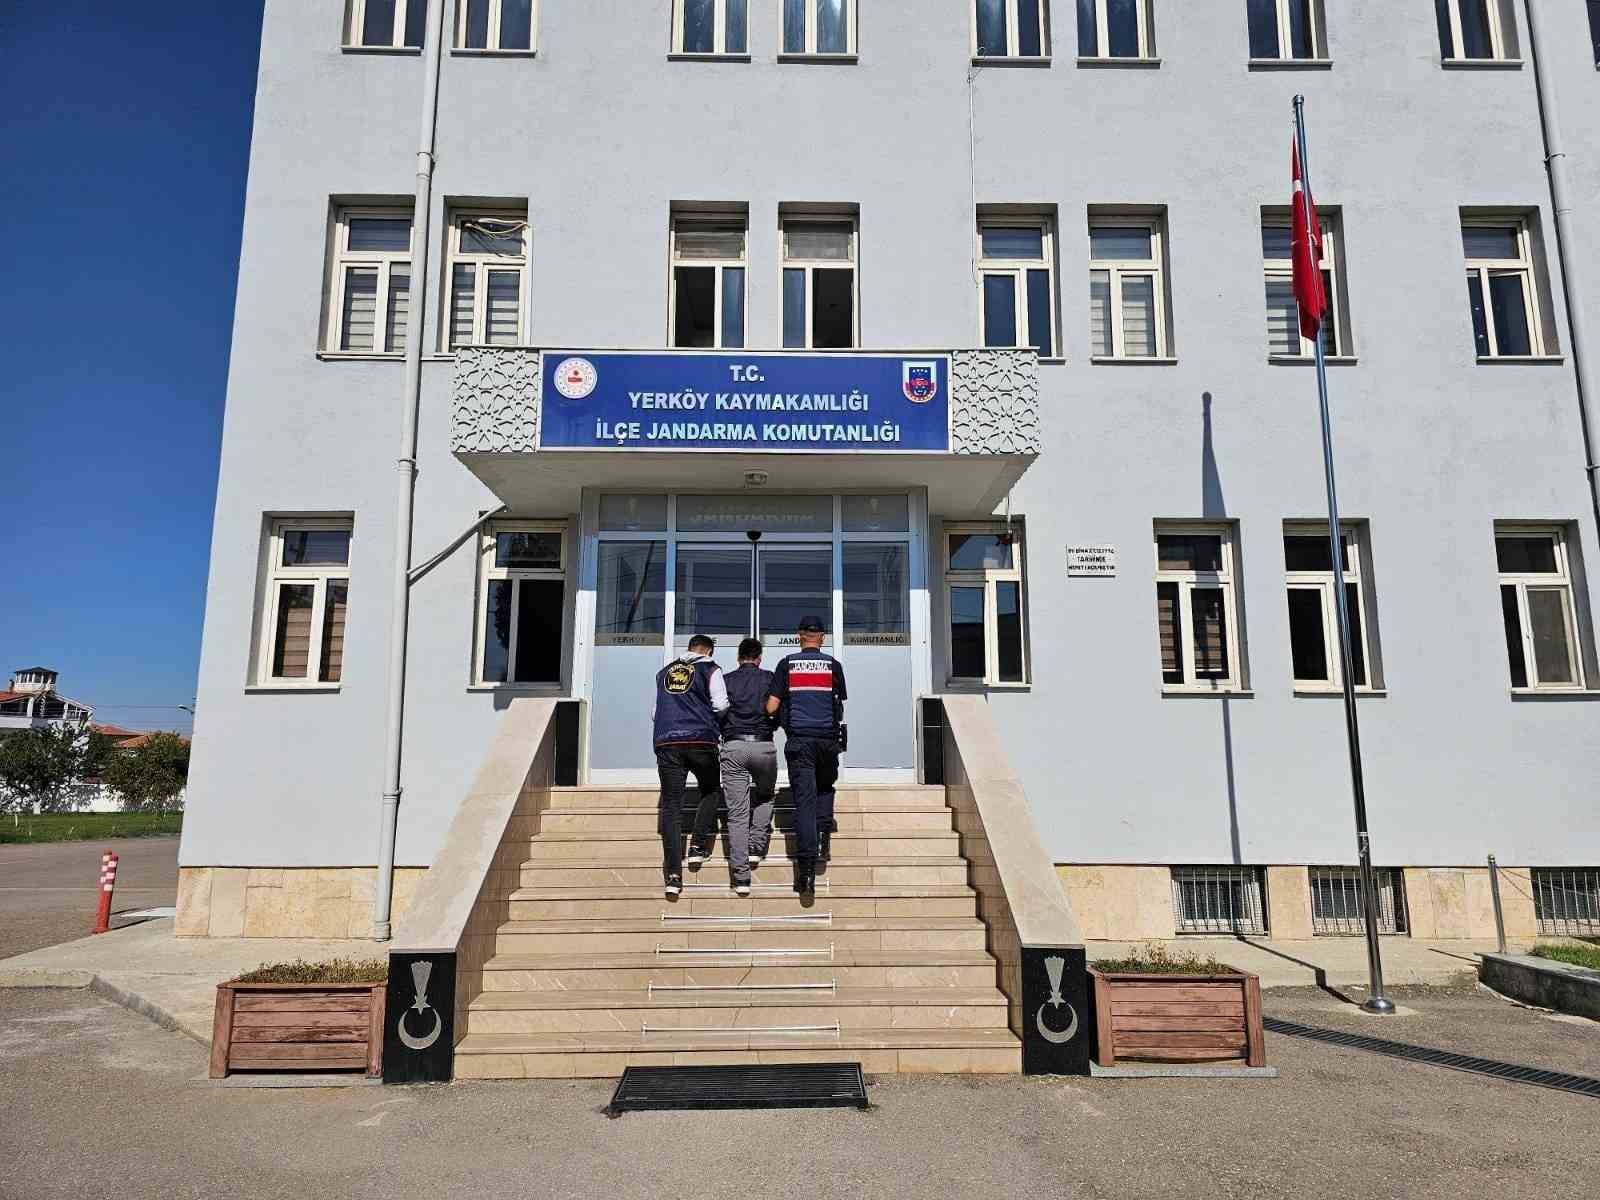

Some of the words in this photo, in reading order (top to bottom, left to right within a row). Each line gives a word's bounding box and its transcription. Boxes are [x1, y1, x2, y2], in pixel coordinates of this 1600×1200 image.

[729, 365, 765, 382] T.C.
[628, 388, 709, 410] YERKÖY
[715, 389, 869, 411] KAYMAKAMLIĞI
[596, 417, 641, 445] İLÇE
[647, 422, 757, 441] JANDARMA
[763, 420, 900, 442] KOMUTANLIĞI
